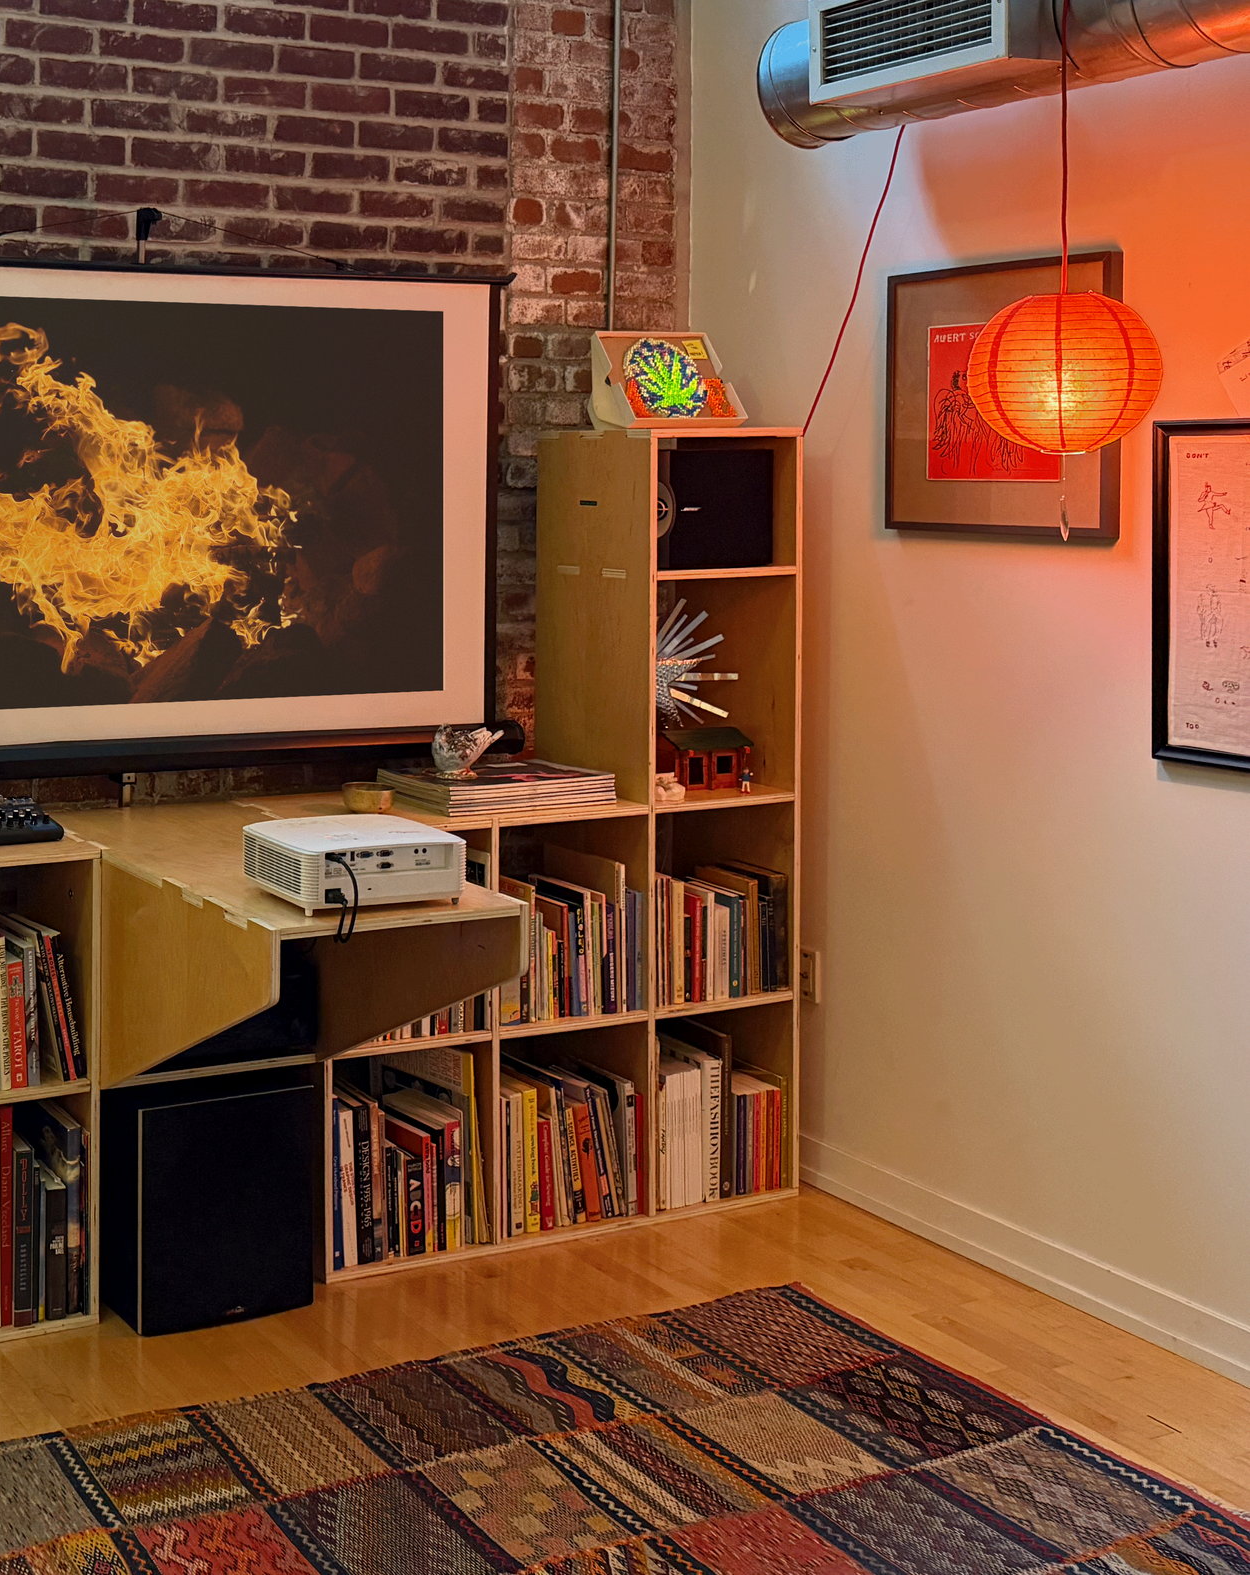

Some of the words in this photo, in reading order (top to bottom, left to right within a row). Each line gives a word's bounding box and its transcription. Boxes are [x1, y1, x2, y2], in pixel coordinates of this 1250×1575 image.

[56, 954, 70, 998] Alternative
[64, 998, 80, 1056] Housebuilding
[13, 1029, 22, 1070] TAROT
[2, 1121, 10, 1153] Allure
[542, 1124, 550, 1153] Complete
[567, 1122, 575, 1146] SCIENCE
[361, 1141, 370, 1181] DESIGN
[570, 1150, 580, 1182] ACTIVITIES
[1, 1166, 10, 1198] Diana
[362, 1184, 372, 1228] 1935-1965
[0, 1201, 10, 1248] Vreeland
